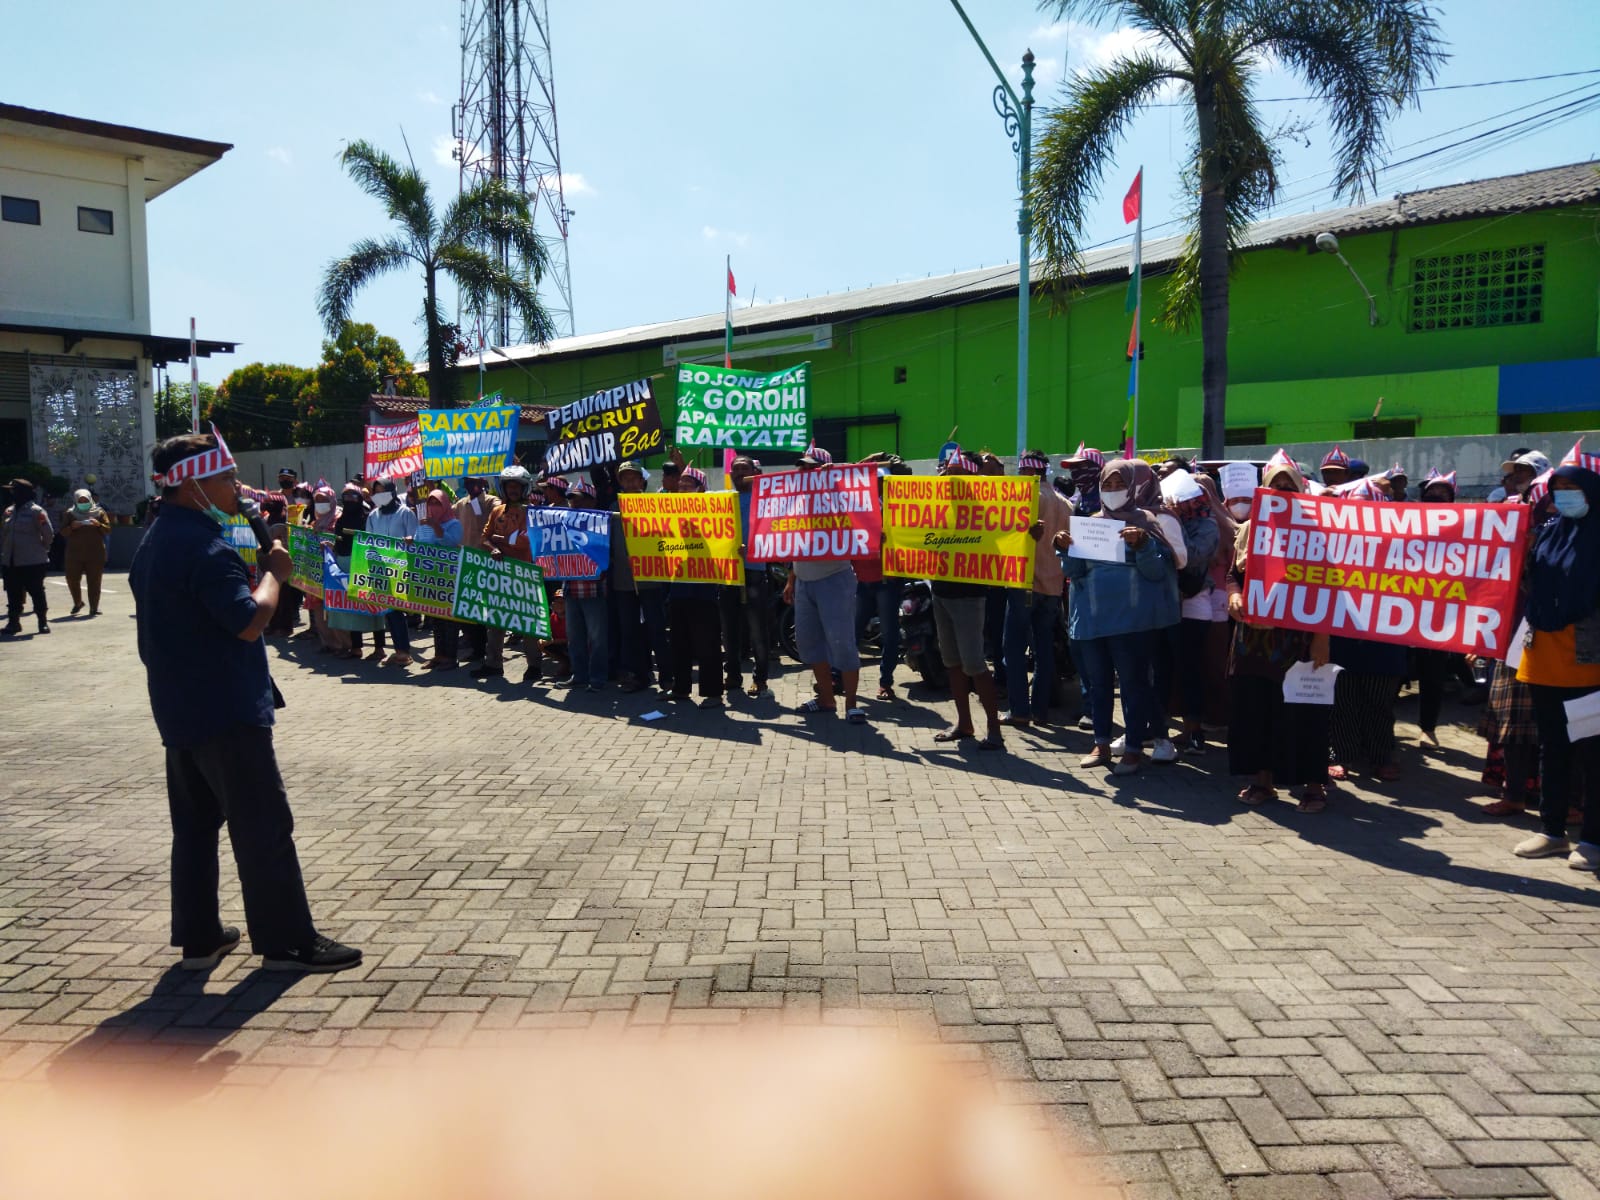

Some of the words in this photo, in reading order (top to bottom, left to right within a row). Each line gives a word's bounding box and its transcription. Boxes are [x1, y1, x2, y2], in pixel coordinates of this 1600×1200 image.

[678, 369, 766, 389] BOJONE
[768, 369, 807, 387] BAE
[548, 379, 651, 430] PEMIMPIN
[677, 390, 696, 407] di
[703, 386, 806, 411] GOROHI
[418, 410, 515, 431] RAKYAT
[560, 402, 647, 439] KACRUT
[677, 410, 719, 425] APA
[724, 412, 807, 427] MANING
[367, 438, 401, 453] BERBUAT
[446, 429, 512, 455] PEMIMPIN
[545, 432, 616, 474] MUNDUR
[620, 425, 661, 458] Bae
[676, 426, 808, 447] RAKYATE
[424, 456, 465, 478] YANG
[467, 454, 507, 475] BAIK
[758, 466, 871, 497] PEMIMPIN
[887, 481, 932, 500] NGURUS
[935, 481, 998, 501] KELUARGA
[1001, 481, 1032, 502] SAJA
[620, 497, 656, 514] NGURUS
[658, 497, 708, 514] KELUARGA
[710, 497, 734, 514] SAJA
[757, 494, 812, 518] BERBUAT
[813, 490, 873, 514] ASUSILA
[528, 508, 610, 535] PEMIMPIN
[622, 517, 675, 538] TIDAK
[678, 517, 736, 540] BECUS
[771, 516, 852, 532] SEBAIKNYA
[888, 503, 950, 529] TIDAK
[955, 505, 1031, 533] BECUS
[1258, 494, 1520, 543] PEMIMPIN
[356, 534, 391, 549] LAGI
[540, 527, 589, 553] PHP
[657, 540, 705, 554] Bagaimana
[753, 529, 869, 559] MUNDUR
[924, 532, 982, 549] Bagaimana
[885, 547, 950, 577] NGURUS
[954, 552, 1029, 584] RAKYAT
[1253, 525, 1383, 568] BERBUAT
[1384, 538, 1512, 582] ASUSILA
[368, 564, 399, 578] JADI
[466, 551, 512, 574] BOJONE
[515, 565, 540, 583] BAE
[686, 557, 740, 581] RAKYAT
[353, 574, 389, 592] ISTRI
[395, 582, 410, 595] DI
[463, 570, 475, 585] di
[477, 570, 544, 604] GOROHI
[1285, 563, 1468, 601] SEBAIKNYA
[461, 587, 485, 604] APA
[488, 594, 547, 618] MANING
[1247, 579, 1501, 650] MUNDUR
[457, 600, 548, 637] RAKYATE
